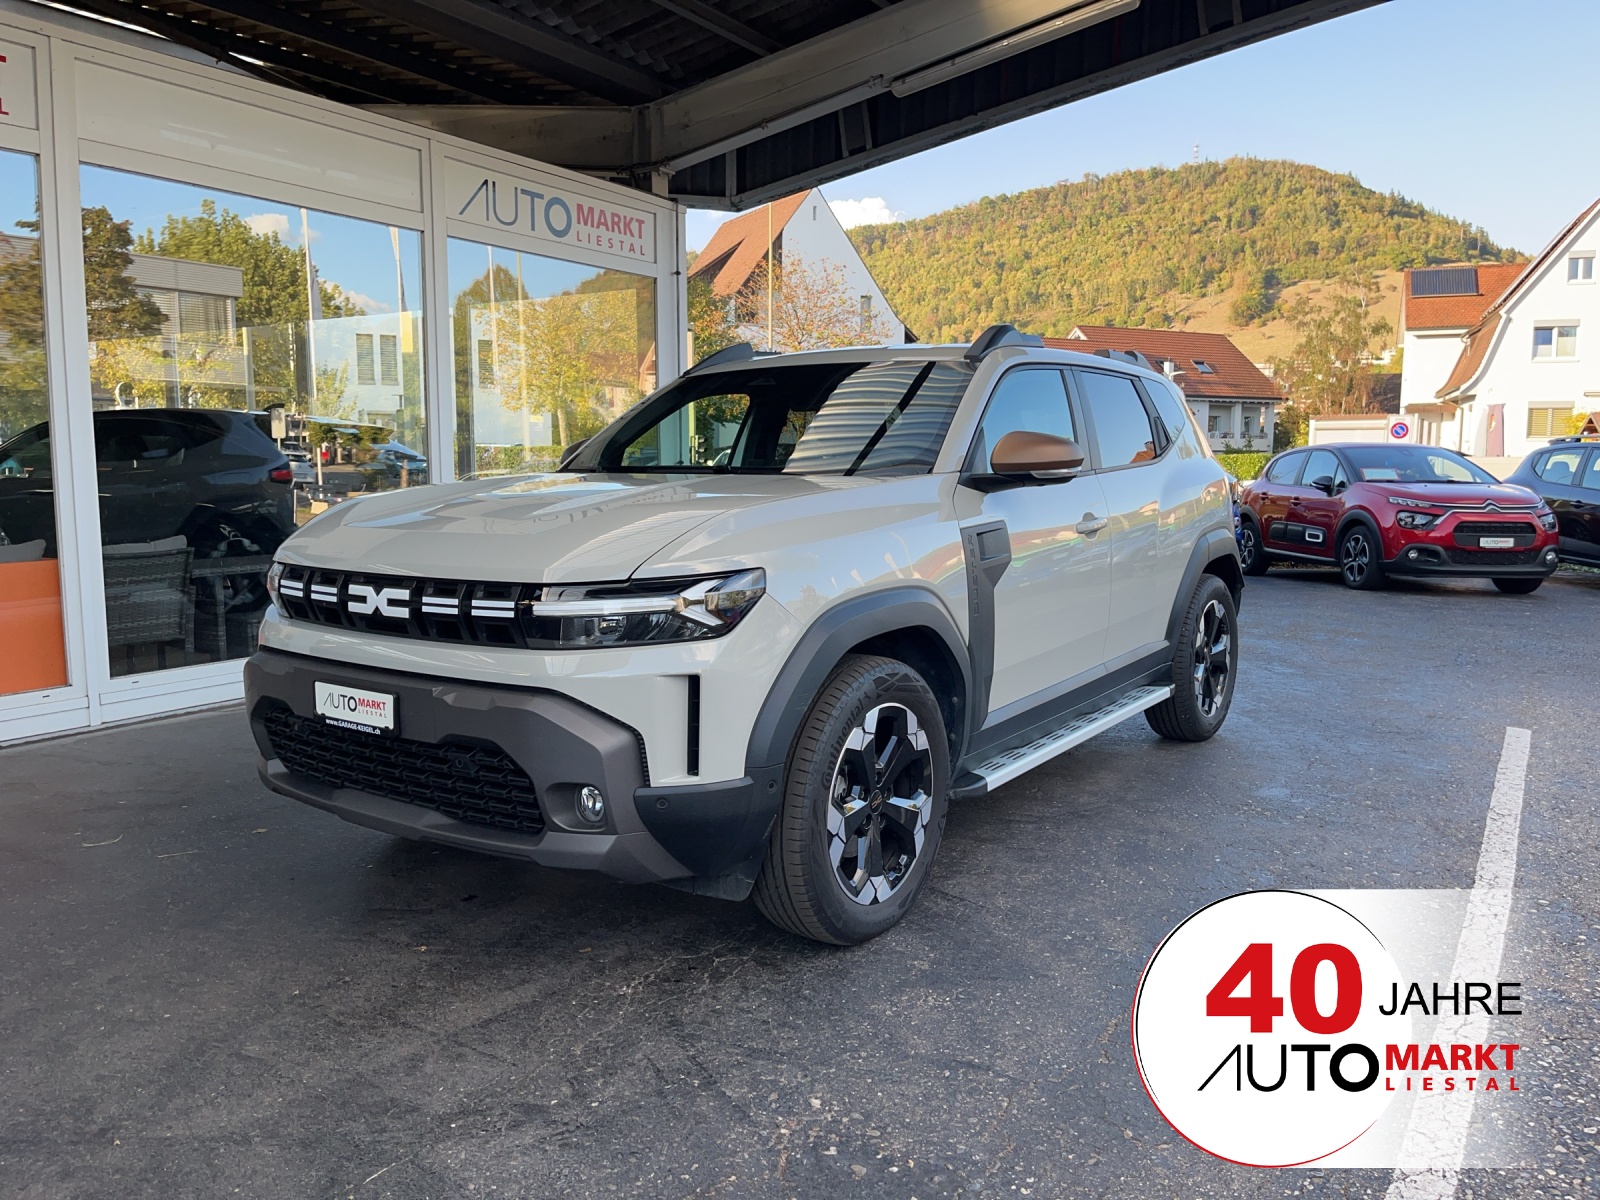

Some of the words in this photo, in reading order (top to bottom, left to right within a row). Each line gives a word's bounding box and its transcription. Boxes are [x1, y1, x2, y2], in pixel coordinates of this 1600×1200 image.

[458, 179, 573, 238] AUTO
[576, 203, 645, 240] MARKT
[576, 230, 646, 256] LIESTAL
[323, 692, 358, 713] AUTO
[358, 697, 387, 712] MARKT
[358, 708, 387, 719] LIESTAL
